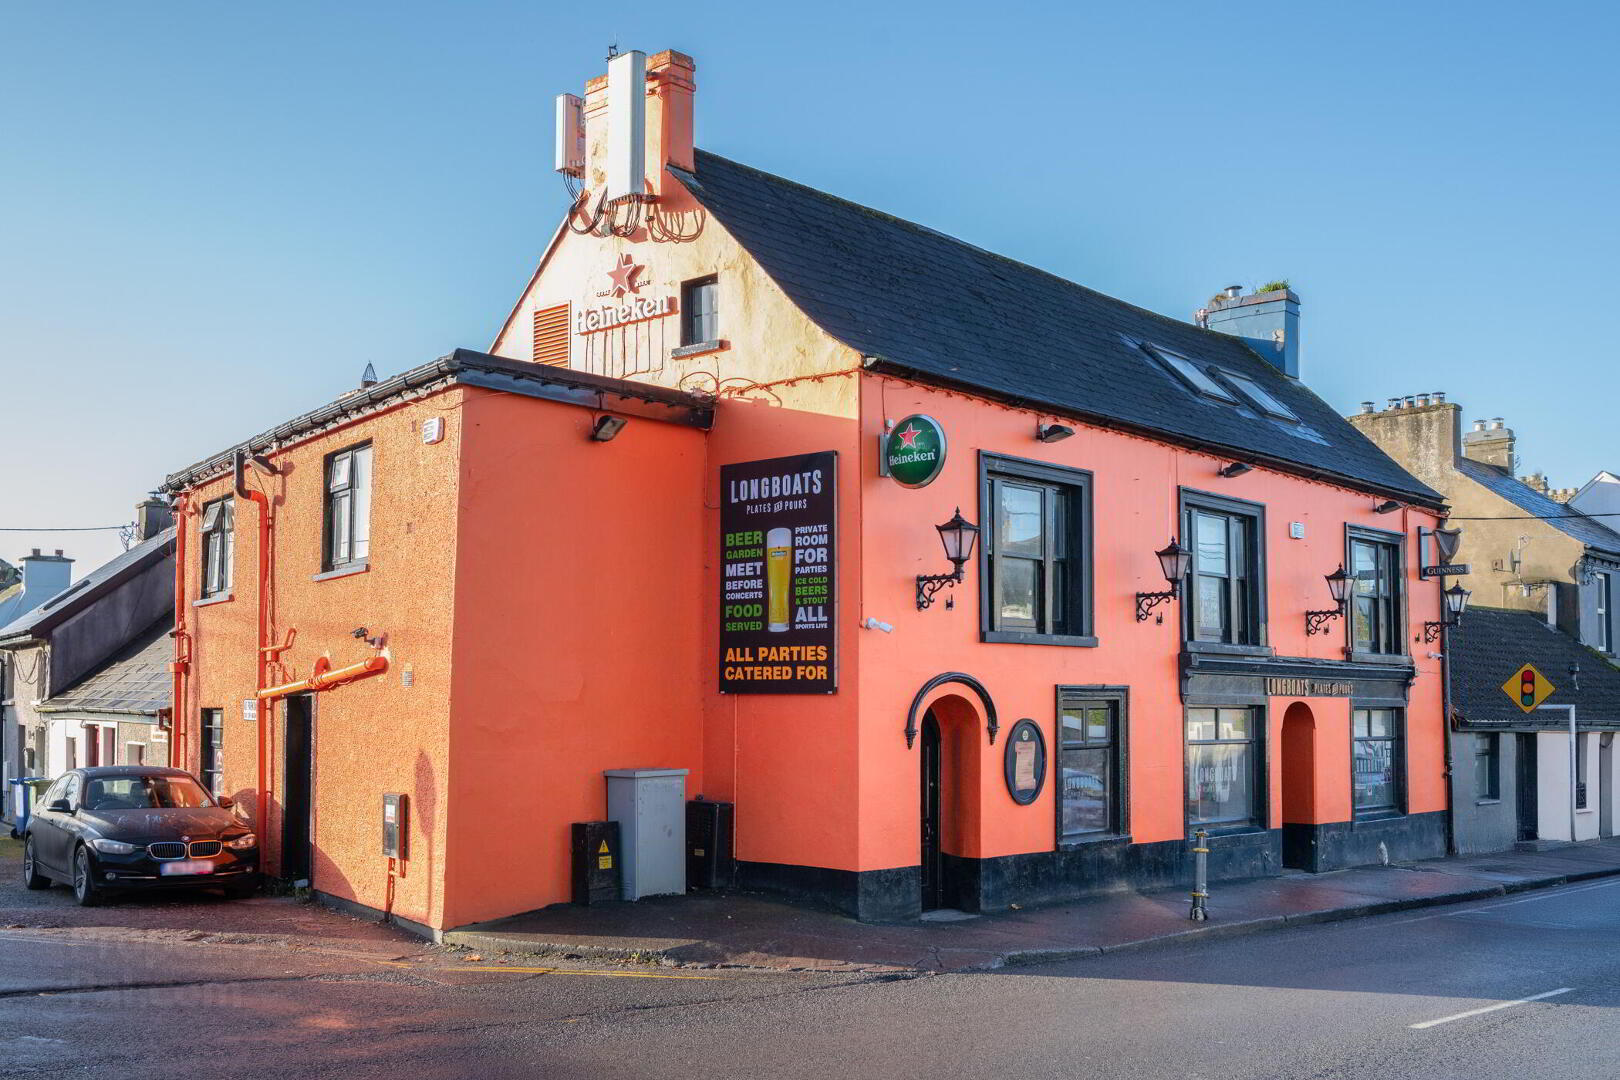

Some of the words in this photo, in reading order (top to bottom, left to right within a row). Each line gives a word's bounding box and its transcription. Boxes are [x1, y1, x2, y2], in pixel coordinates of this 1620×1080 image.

[576, 296, 669, 333] Heineken
[889, 450, 936, 466] Heineken
[731, 469, 822, 504] LONGBOATS
[746, 502, 771, 515] PLATES
[773, 500, 783, 513] AND
[784, 498, 807, 511] POURS
[795, 524, 828, 534] PRIVATE
[725, 531, 763, 547] BEER
[795, 534, 828, 546] ROOM
[726, 548, 763, 560] GARDEN
[795, 547, 828, 564] FOR
[725, 561, 763, 577] MEET
[795, 565, 828, 574] PARTIES
[1427, 567, 1464, 575] GUINNESS
[725, 579, 763, 590] BEFORE
[795, 577, 807, 585] ICE
[808, 576, 828, 584] COLD
[725, 591, 763, 600] CONCERTS
[795, 585, 828, 595] BEERS
[803, 596, 828, 604] STOUT
[725, 604, 763, 618] FOOD
[795, 606, 828, 622] ALL
[725, 621, 762, 632] SERVED
[725, 648, 754, 662] ALL
[758, 645, 828, 662] PARTIES
[724, 666, 793, 680] CATERED
[796, 665, 828, 680] FOR
[1267, 677, 1309, 696] LONGBOATS
